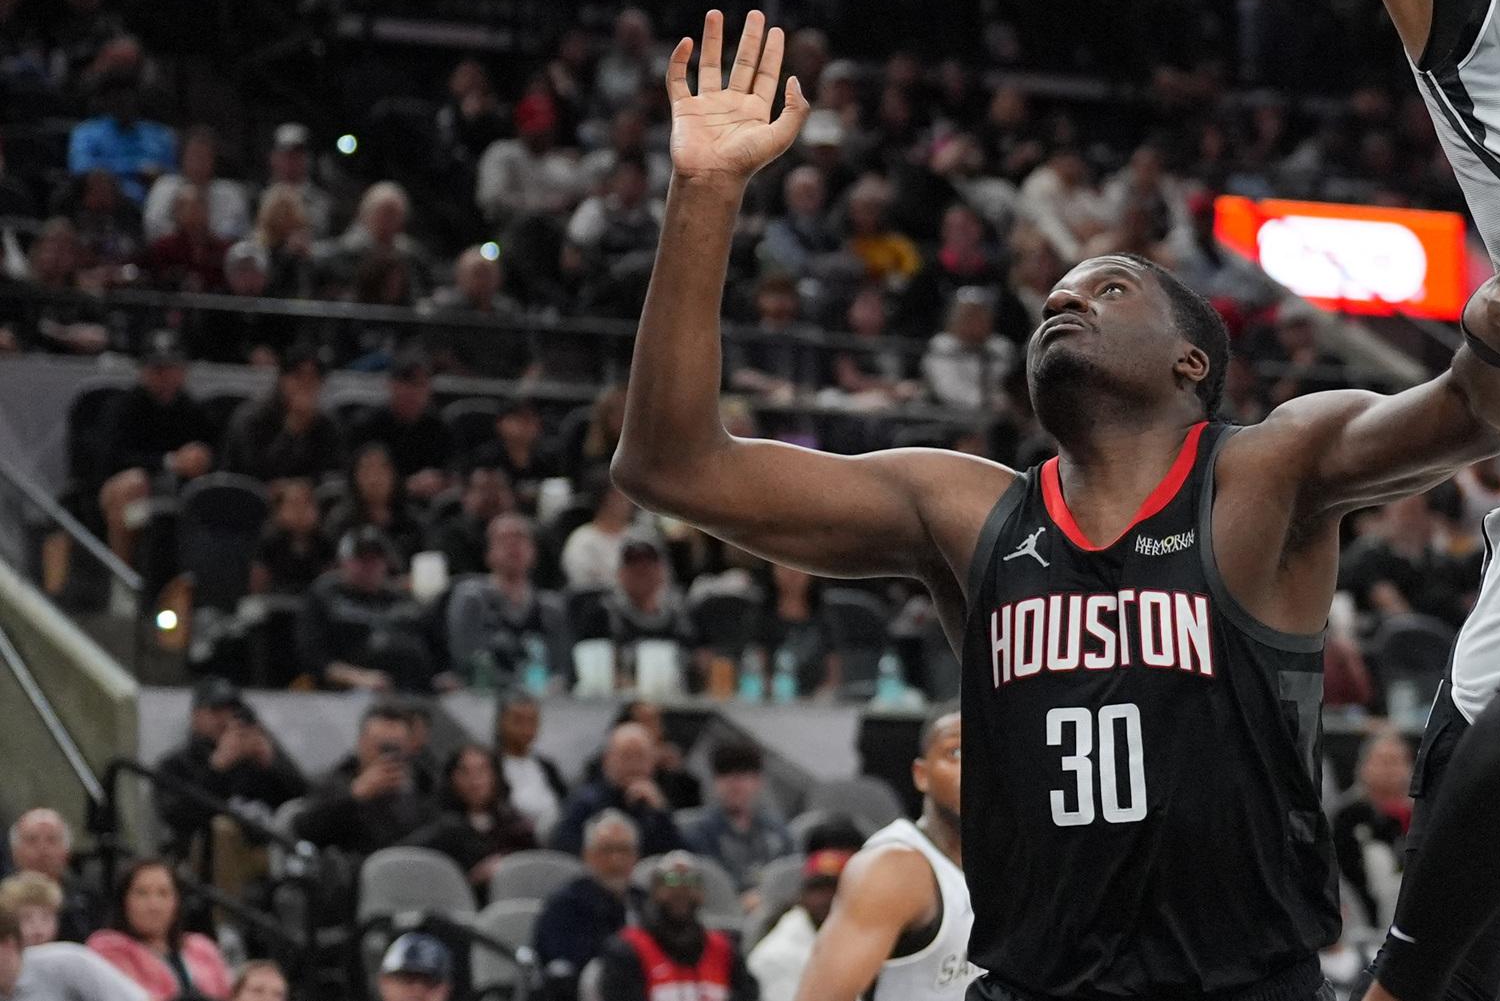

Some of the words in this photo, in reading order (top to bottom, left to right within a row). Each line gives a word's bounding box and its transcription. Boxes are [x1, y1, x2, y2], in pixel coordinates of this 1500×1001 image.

[1135, 536, 1195, 556] HERMANN
[1136, 528, 1195, 548] MEMORIAL
[990, 587, 1216, 689] HOUSTON
[1046, 703, 1148, 827] 30
